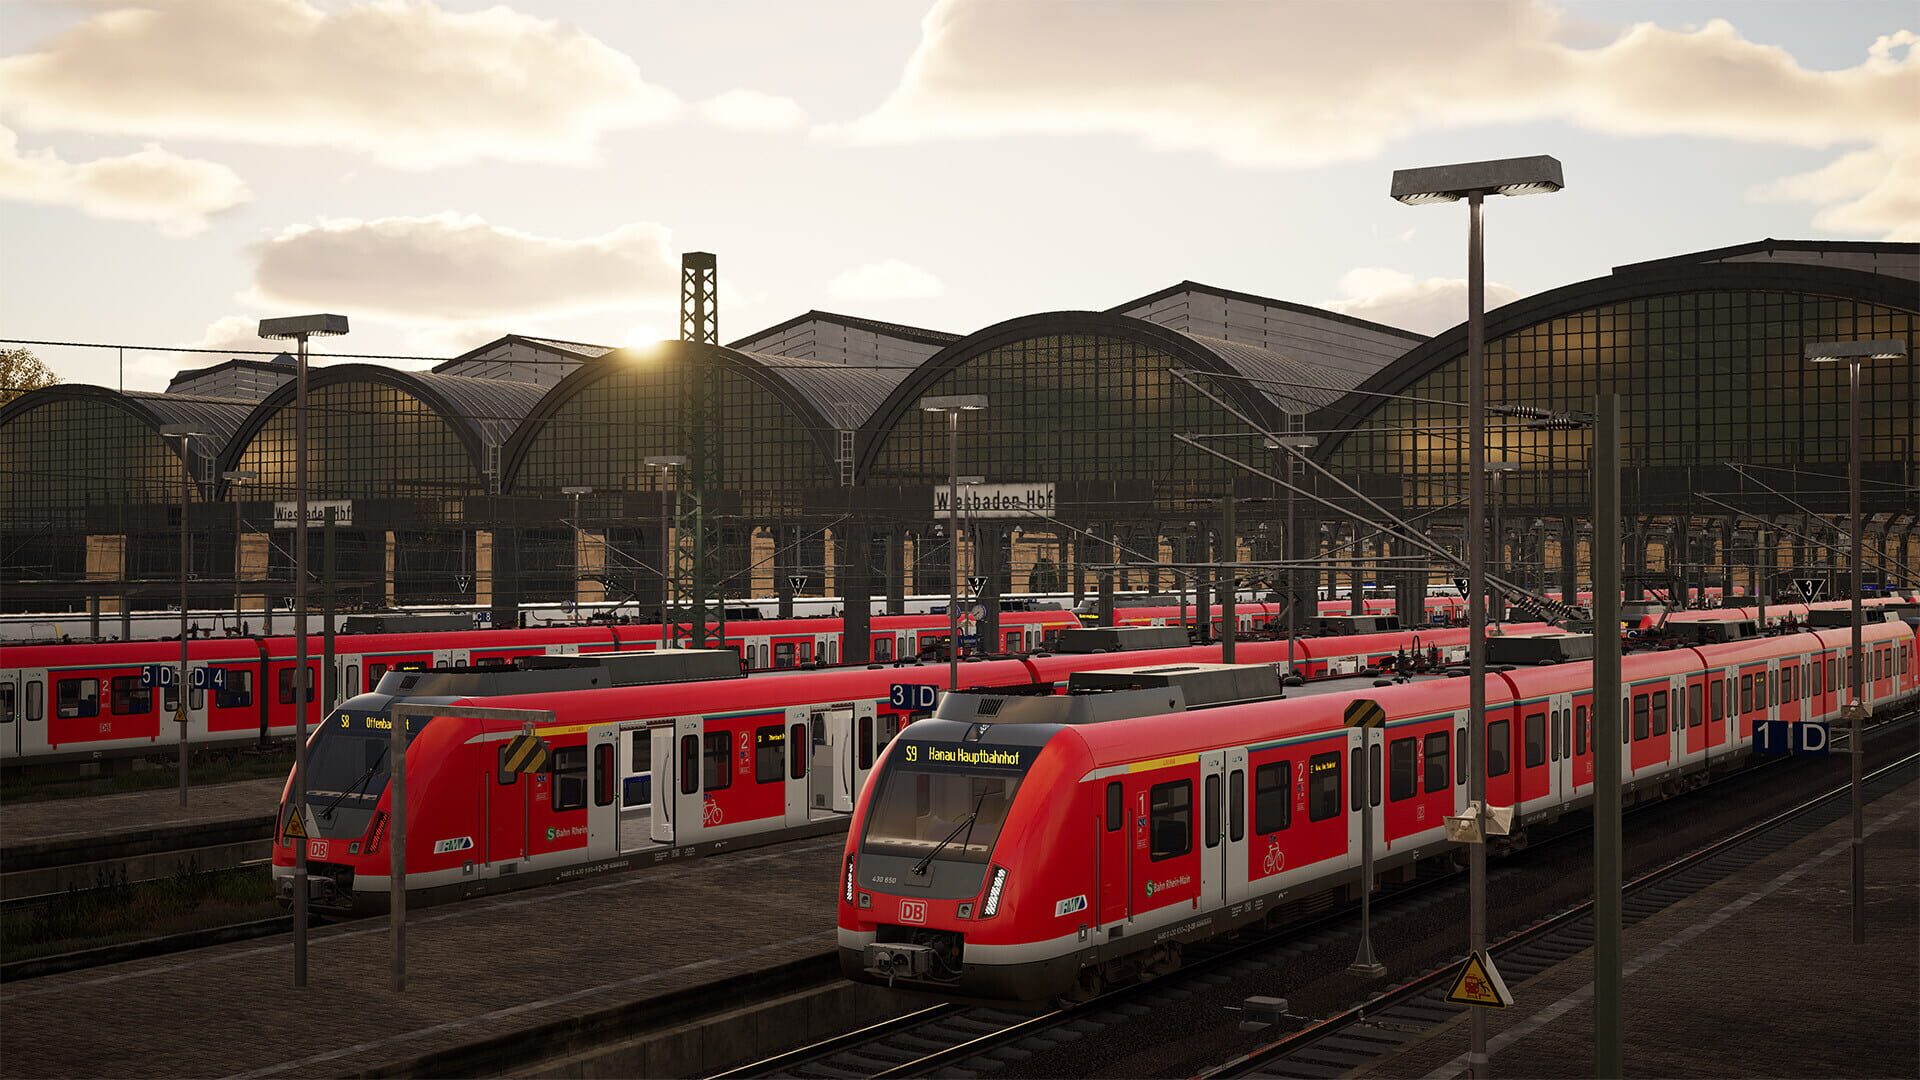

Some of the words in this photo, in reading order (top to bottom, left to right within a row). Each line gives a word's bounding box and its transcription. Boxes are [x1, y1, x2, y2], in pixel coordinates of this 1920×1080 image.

[937, 490, 1019, 510] Wesbaden
[1027, 489, 1053, 509] Hbf
[276, 506, 324, 520] Wiesade
[795, 577, 801, 589] 3
[974, 577, 980, 591] 3
[1462, 579, 1468, 594] 3
[1805, 580, 1813, 596] 3
[142, 666, 151, 683] 5
[160, 667, 171, 684] D
[194, 668, 205, 686] D
[214, 669, 223, 687] 4
[102, 679, 109, 692] 2
[892, 685, 904, 706] 3
[920, 686, 935, 707] D
[341, 714, 350, 728] S8
[366, 716, 393, 730] Offenba
[741, 733, 748, 749] 2
[1757, 721, 1769, 749] 1
[1802, 723, 1826, 751] D
[905, 745, 918, 762] S9
[928, 746, 956, 762] Hanau
[957, 747, 1020, 765] Hauptbahnhof
[1418, 740, 1424, 757] 2
[1297, 762, 1304, 782] 2
[1138, 793, 1144, 815] 1
[556, 826, 571, 838] Bahn
[310, 841, 327, 858] DB
[872, 875, 884, 883] 430
[1154, 880, 1166, 893] Bahn
[901, 902, 925, 922] DB
